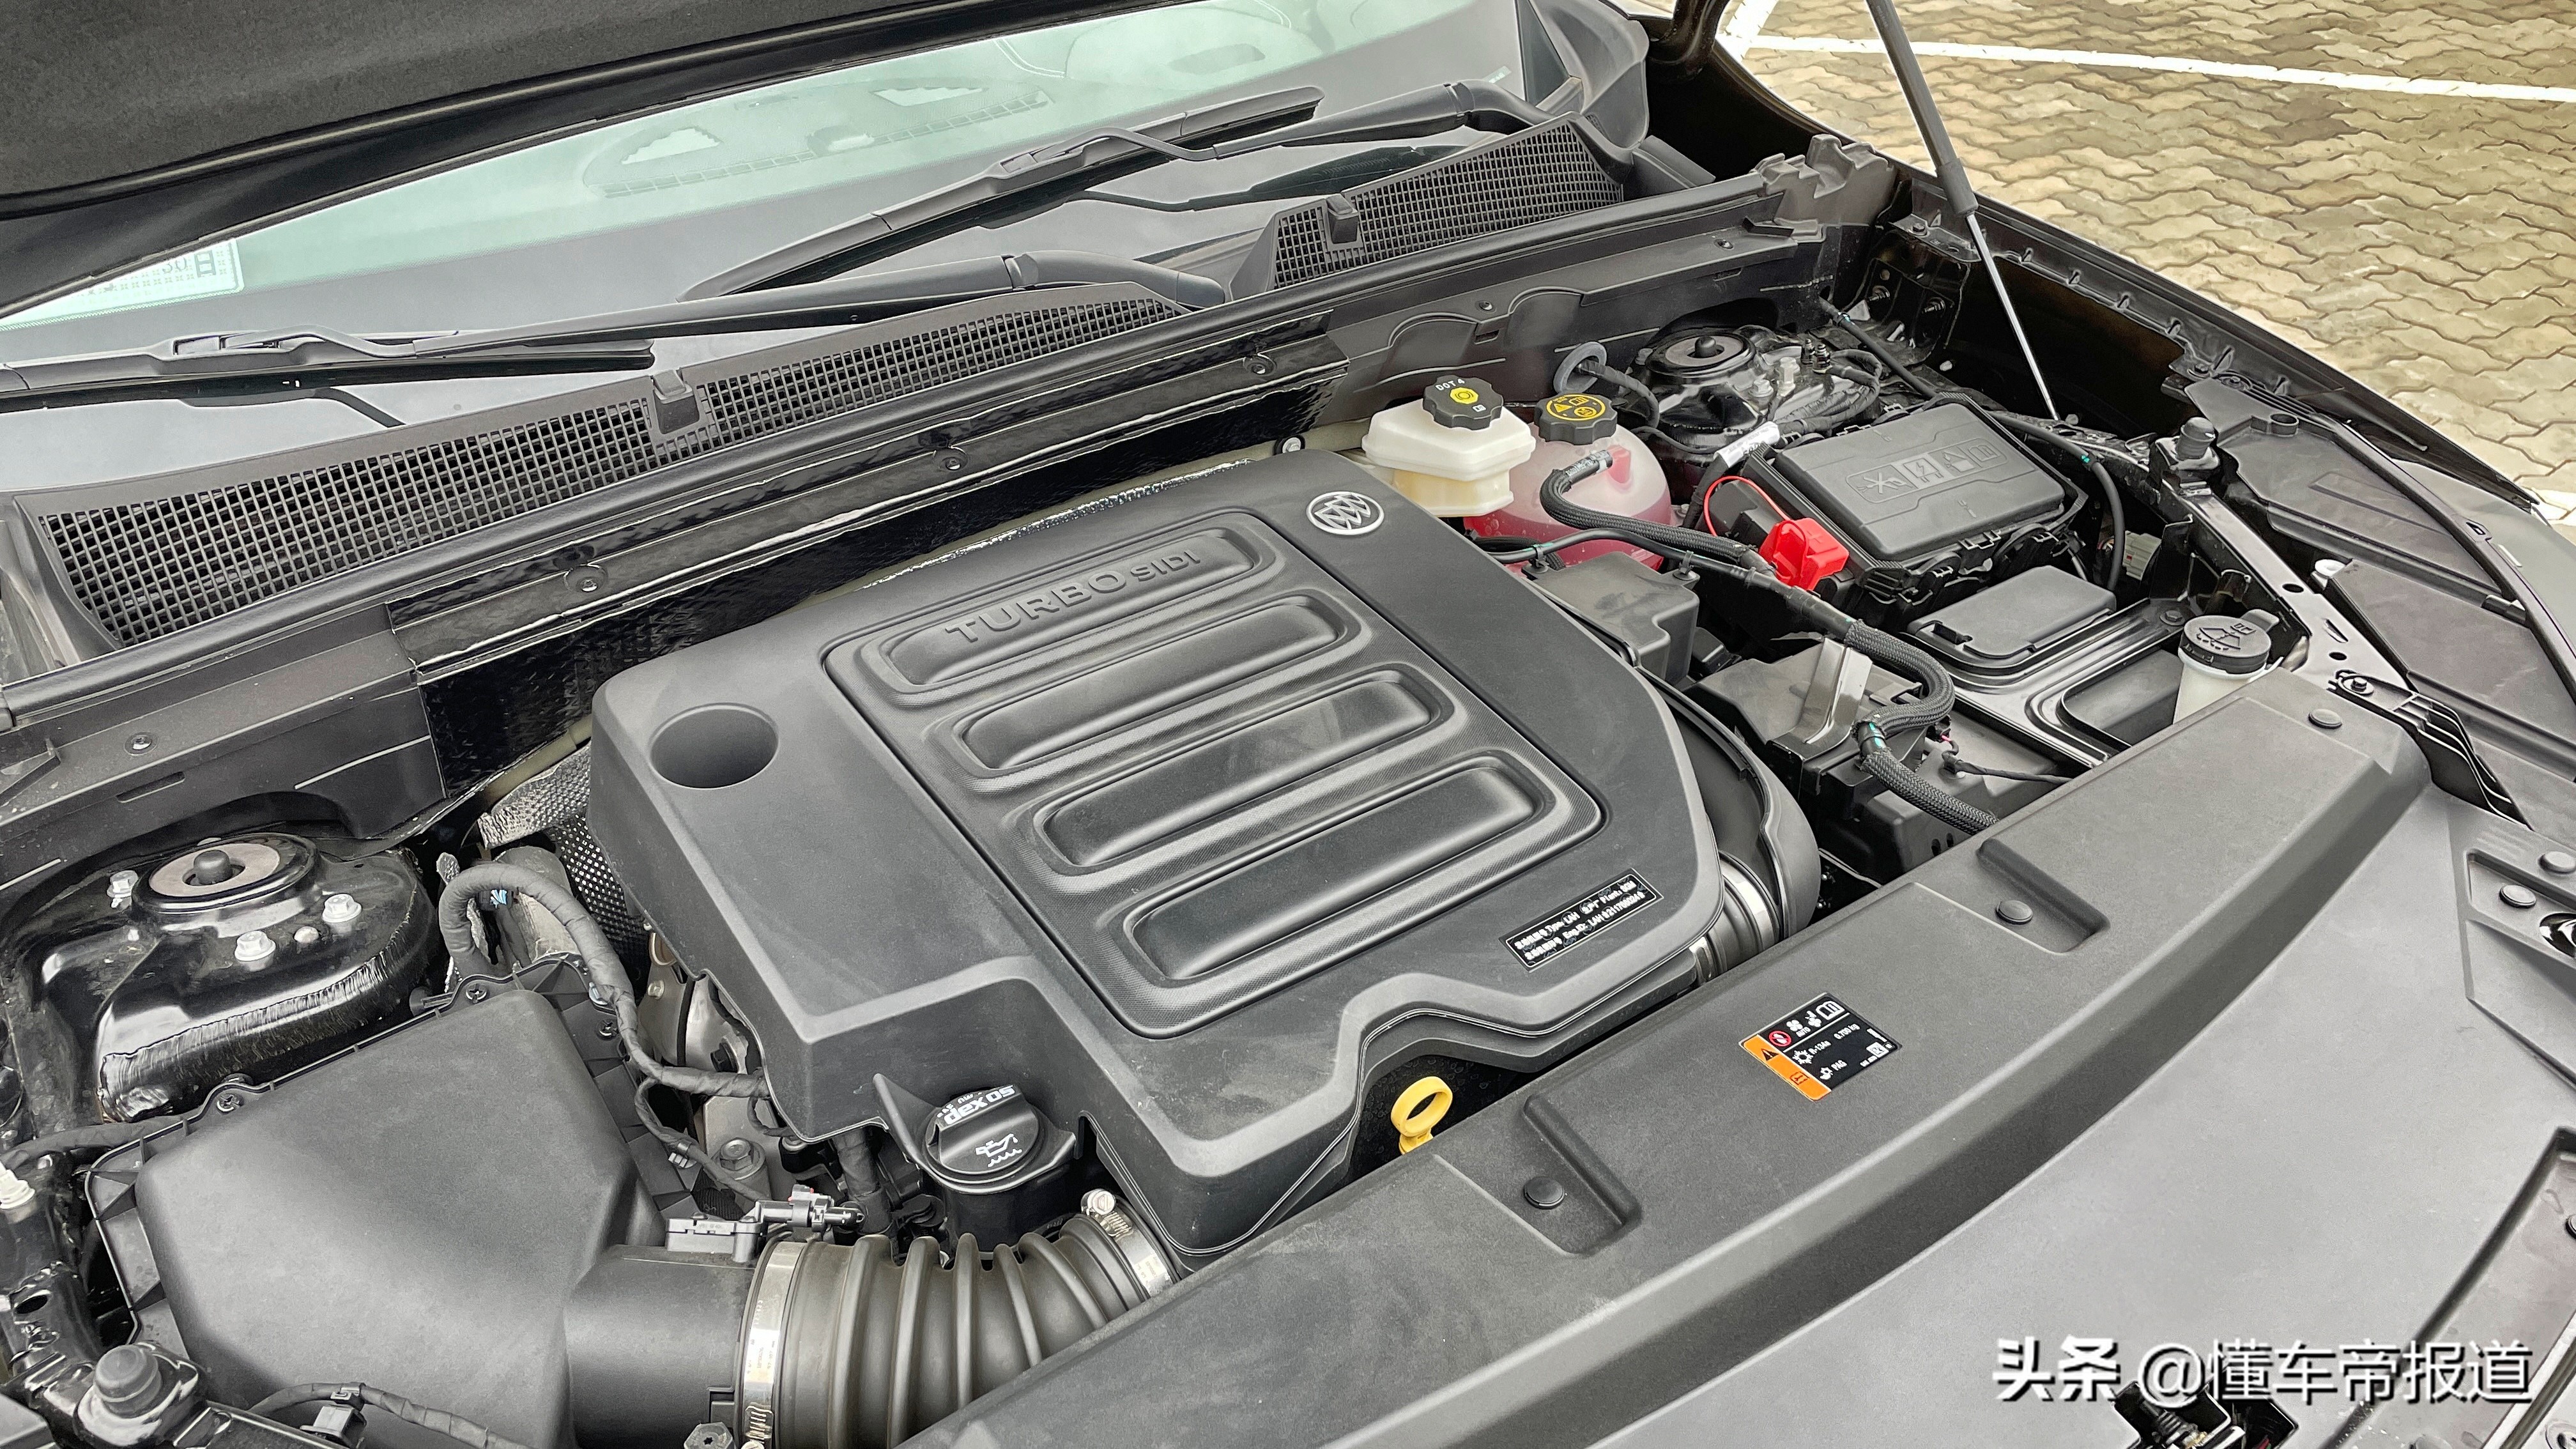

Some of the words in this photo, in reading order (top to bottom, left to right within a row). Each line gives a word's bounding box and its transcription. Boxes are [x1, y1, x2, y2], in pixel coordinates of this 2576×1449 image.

[1435, 380, 1456, 391] DOT
[945, 569, 1127, 643] TURBO
[1130, 549, 1202, 582] SIDI
[1831, 1059, 1847, 1071] PAG
[944, 1084, 1015, 1125] dexos
